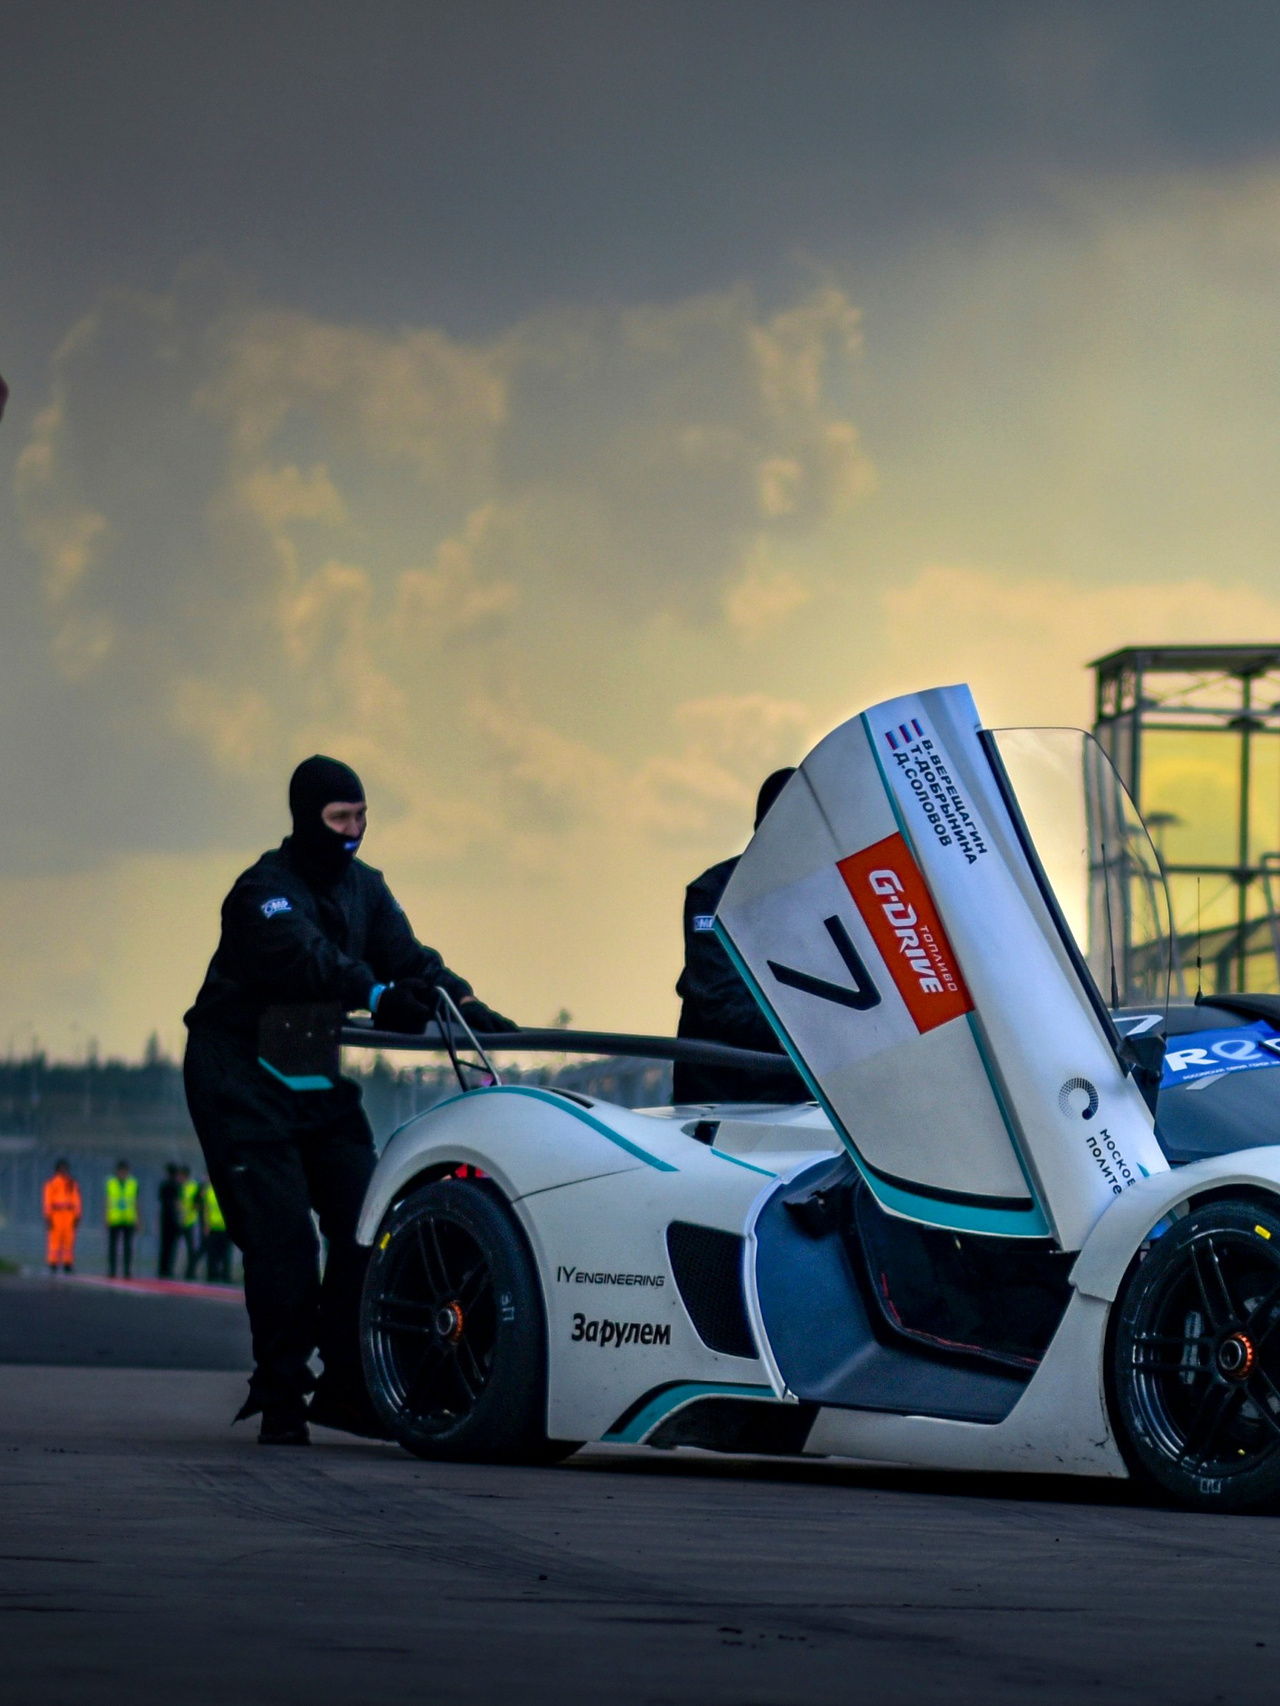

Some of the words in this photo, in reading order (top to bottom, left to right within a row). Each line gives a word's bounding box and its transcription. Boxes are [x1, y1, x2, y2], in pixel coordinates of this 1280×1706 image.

[893, 752, 952, 847] Д.СОЛОВОВ
[910, 744, 977, 865] Т.ДОБРЫНИНА
[922, 740, 988, 854] В.ВЕРЕЩАГИН
[920, 925, 958, 992] ТОПЛИВО
